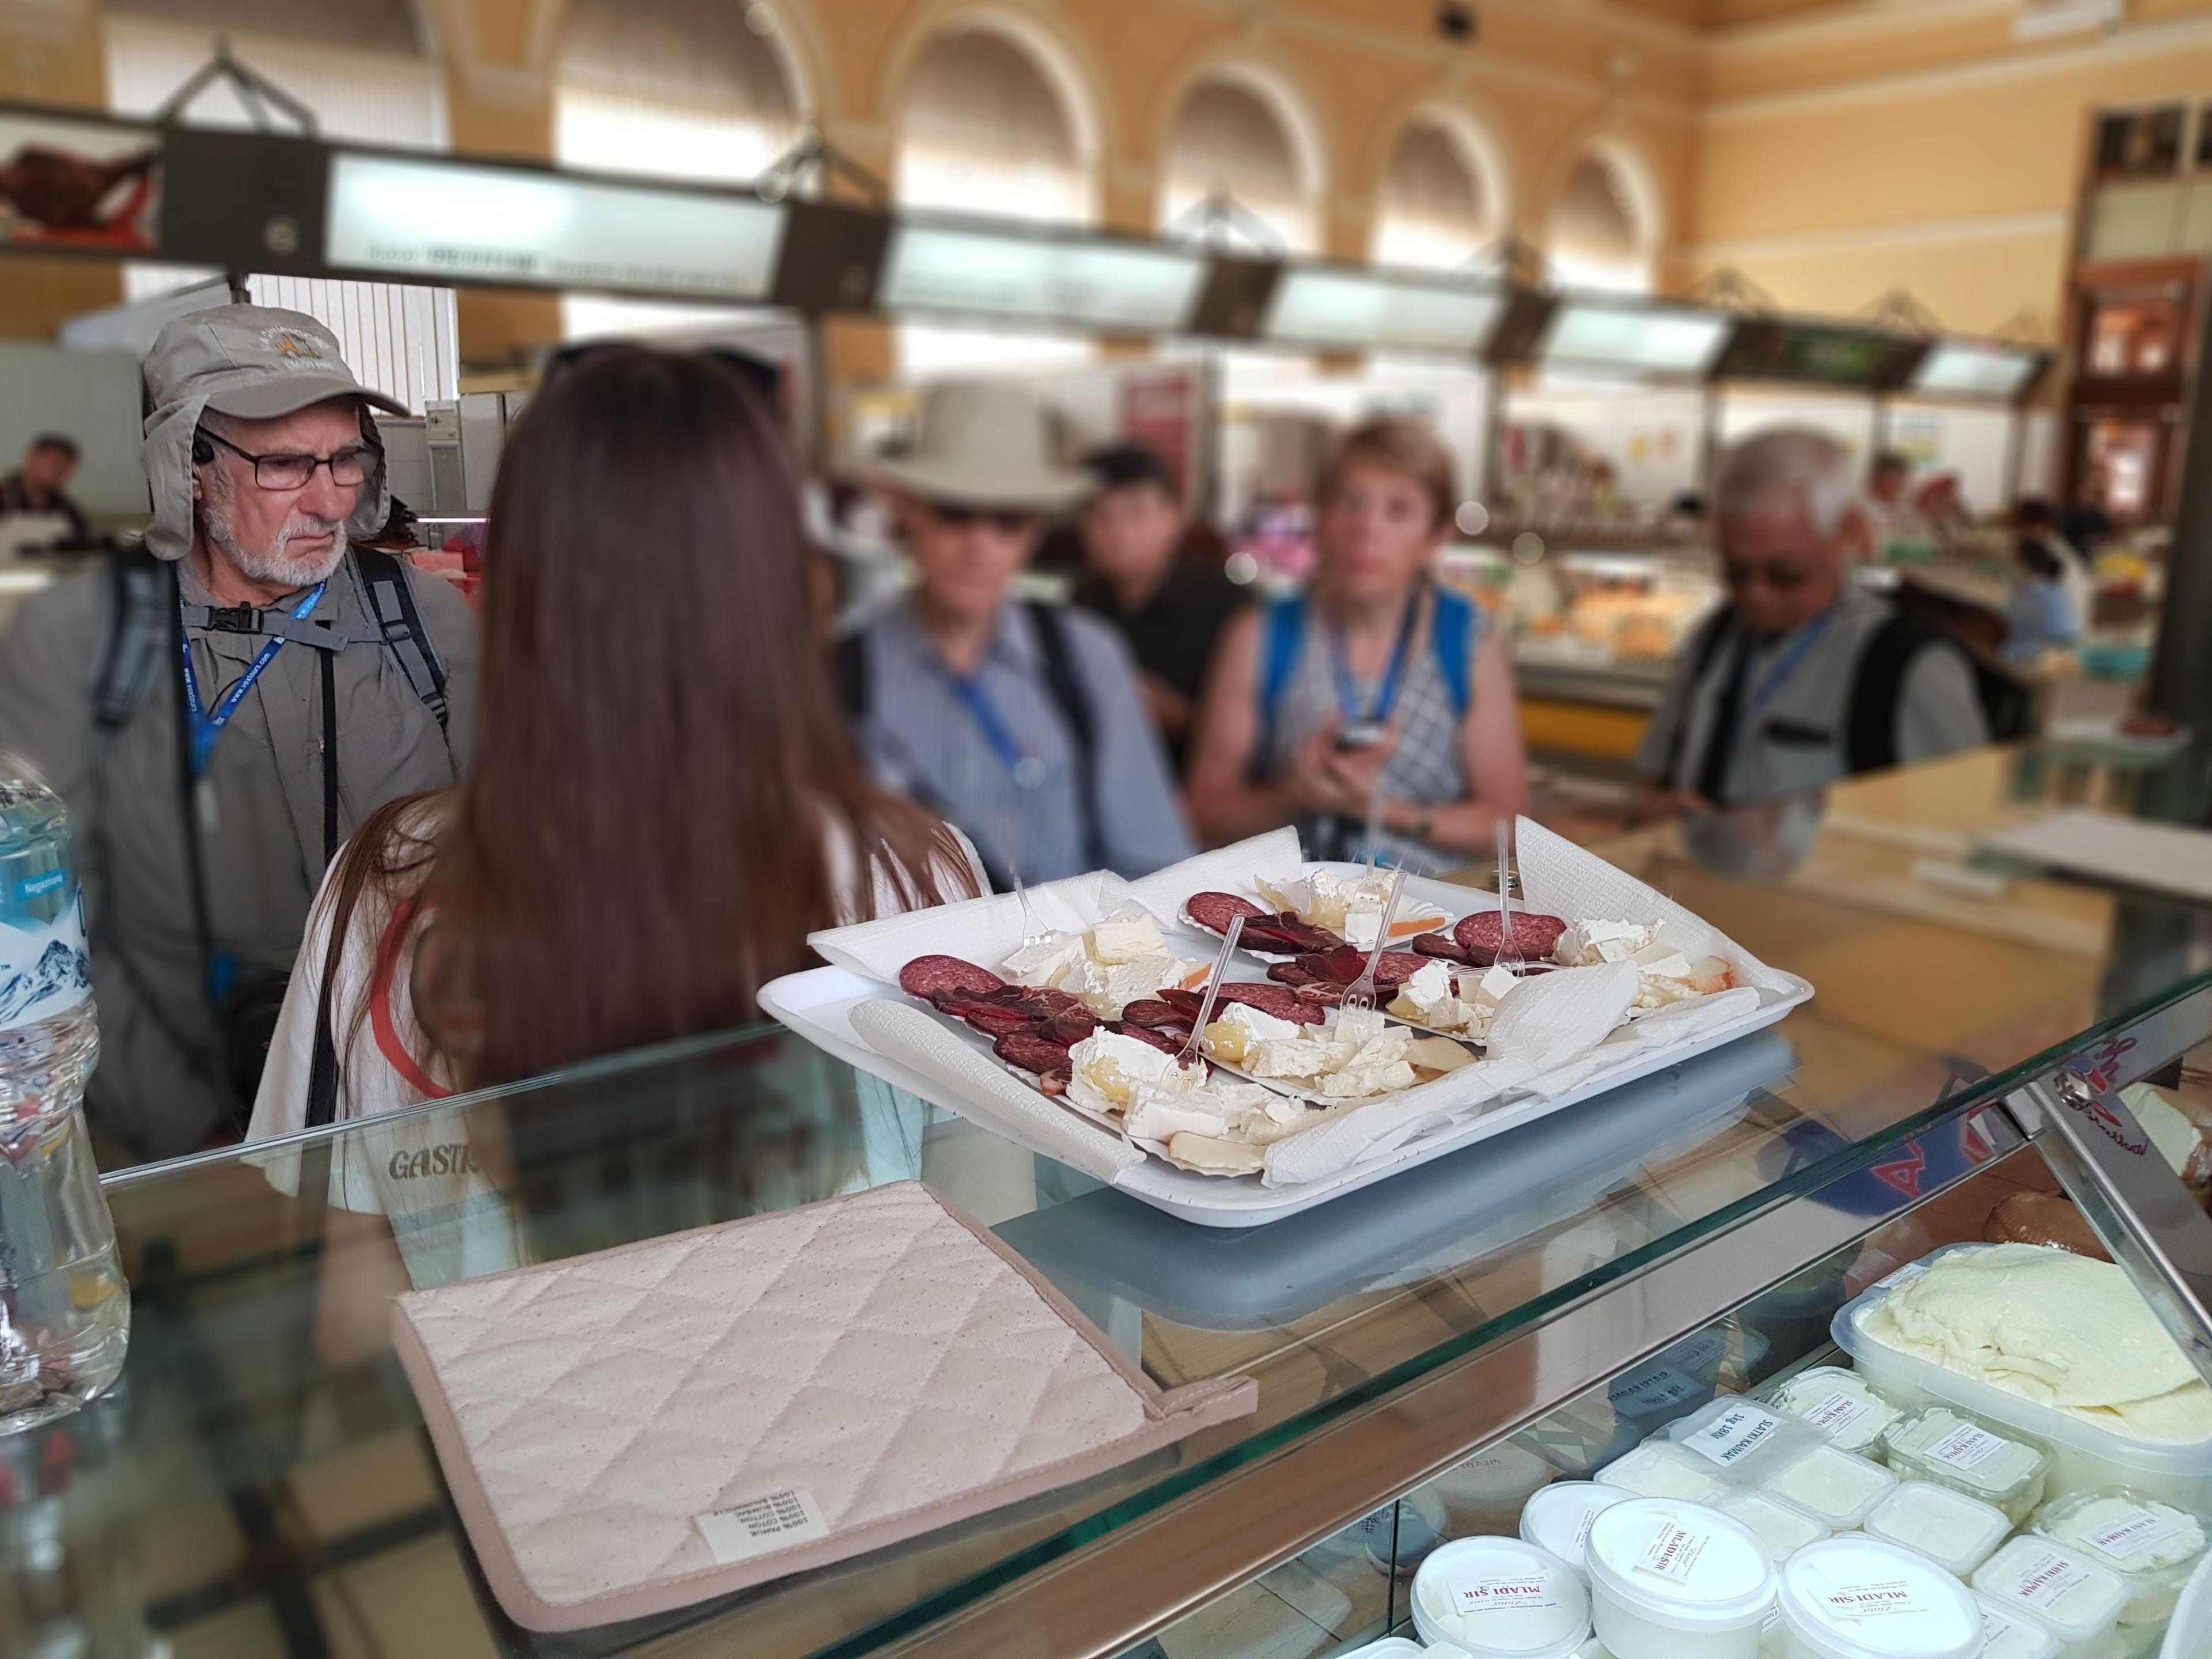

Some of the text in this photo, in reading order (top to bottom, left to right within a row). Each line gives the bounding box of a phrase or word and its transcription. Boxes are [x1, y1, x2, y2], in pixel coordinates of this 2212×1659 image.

[230, 652, 271, 702] www.voxtours.com
[1725, 1413, 1744, 1425] 1kg
[1815, 1412, 1836, 1426] KAJMA
[1719, 1419, 1772, 1461] SLATKI KAJMAK
[1965, 1433, 1984, 1445] SLANI
[1942, 1444, 1968, 1460] KAJMAK
[1663, 1530, 1685, 1558] MLADI
[1654, 1557, 1669, 1570] SIR
[1463, 1589, 1487, 1598] SIR
[1855, 1591, 1907, 1600] MLADI
